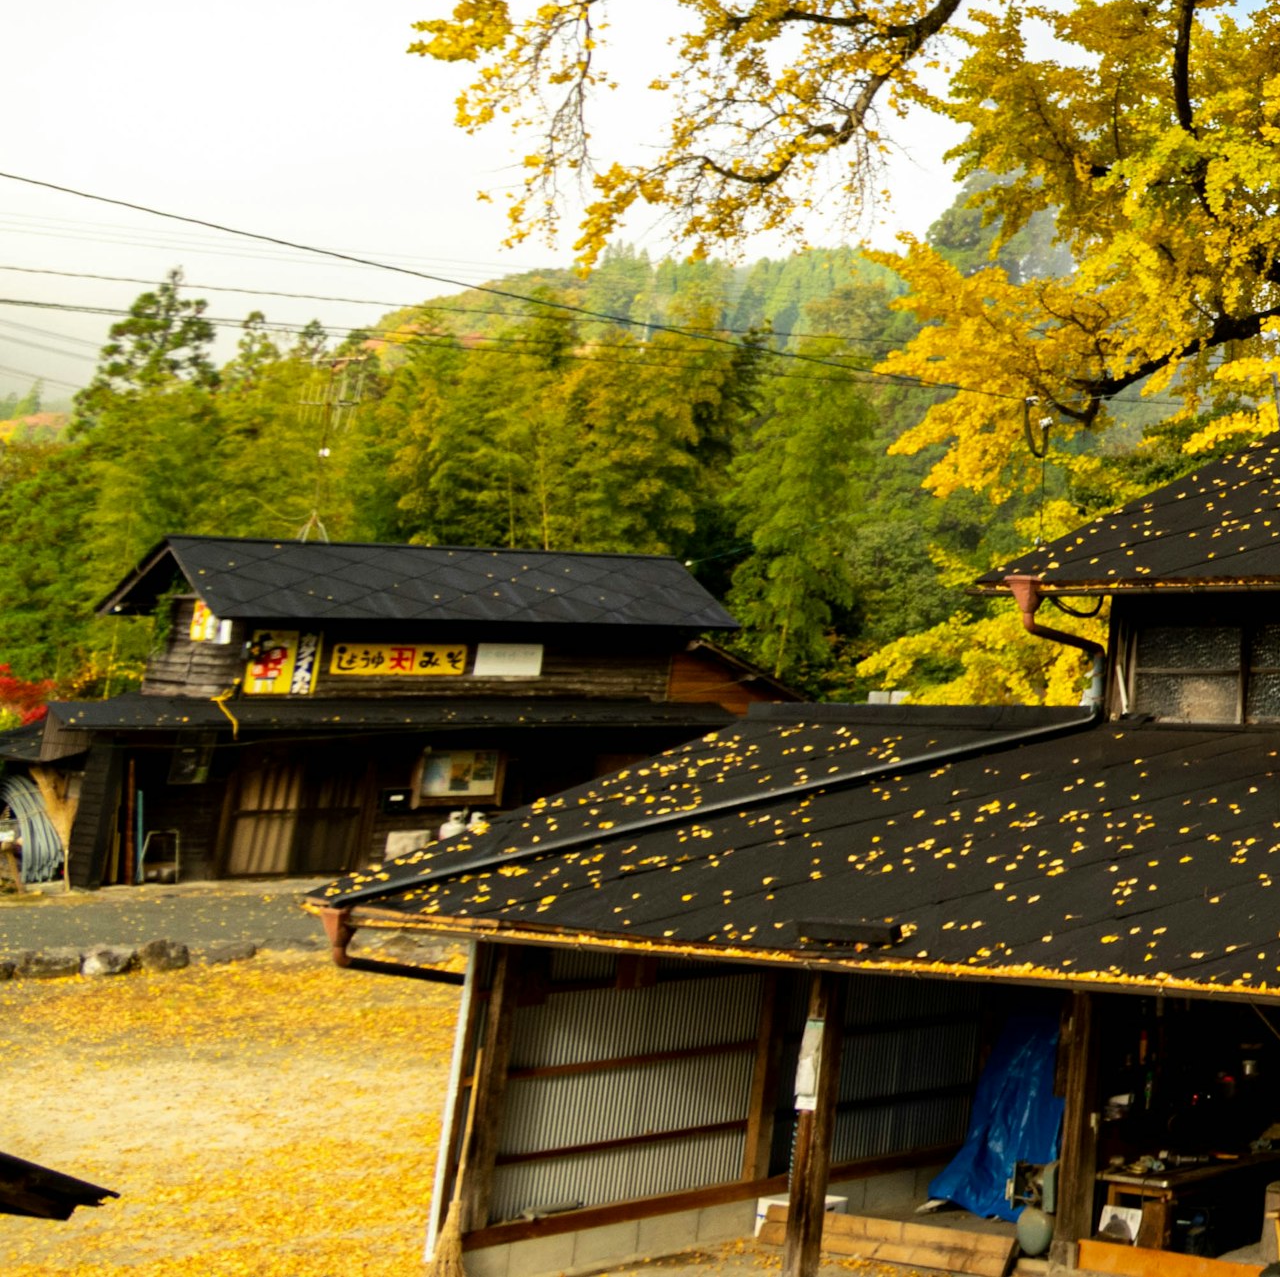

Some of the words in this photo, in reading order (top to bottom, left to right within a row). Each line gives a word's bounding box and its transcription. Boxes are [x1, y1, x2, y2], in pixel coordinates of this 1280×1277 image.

[337, 646, 385, 671] しょうゆ
[419, 650, 463, 670] みそ
